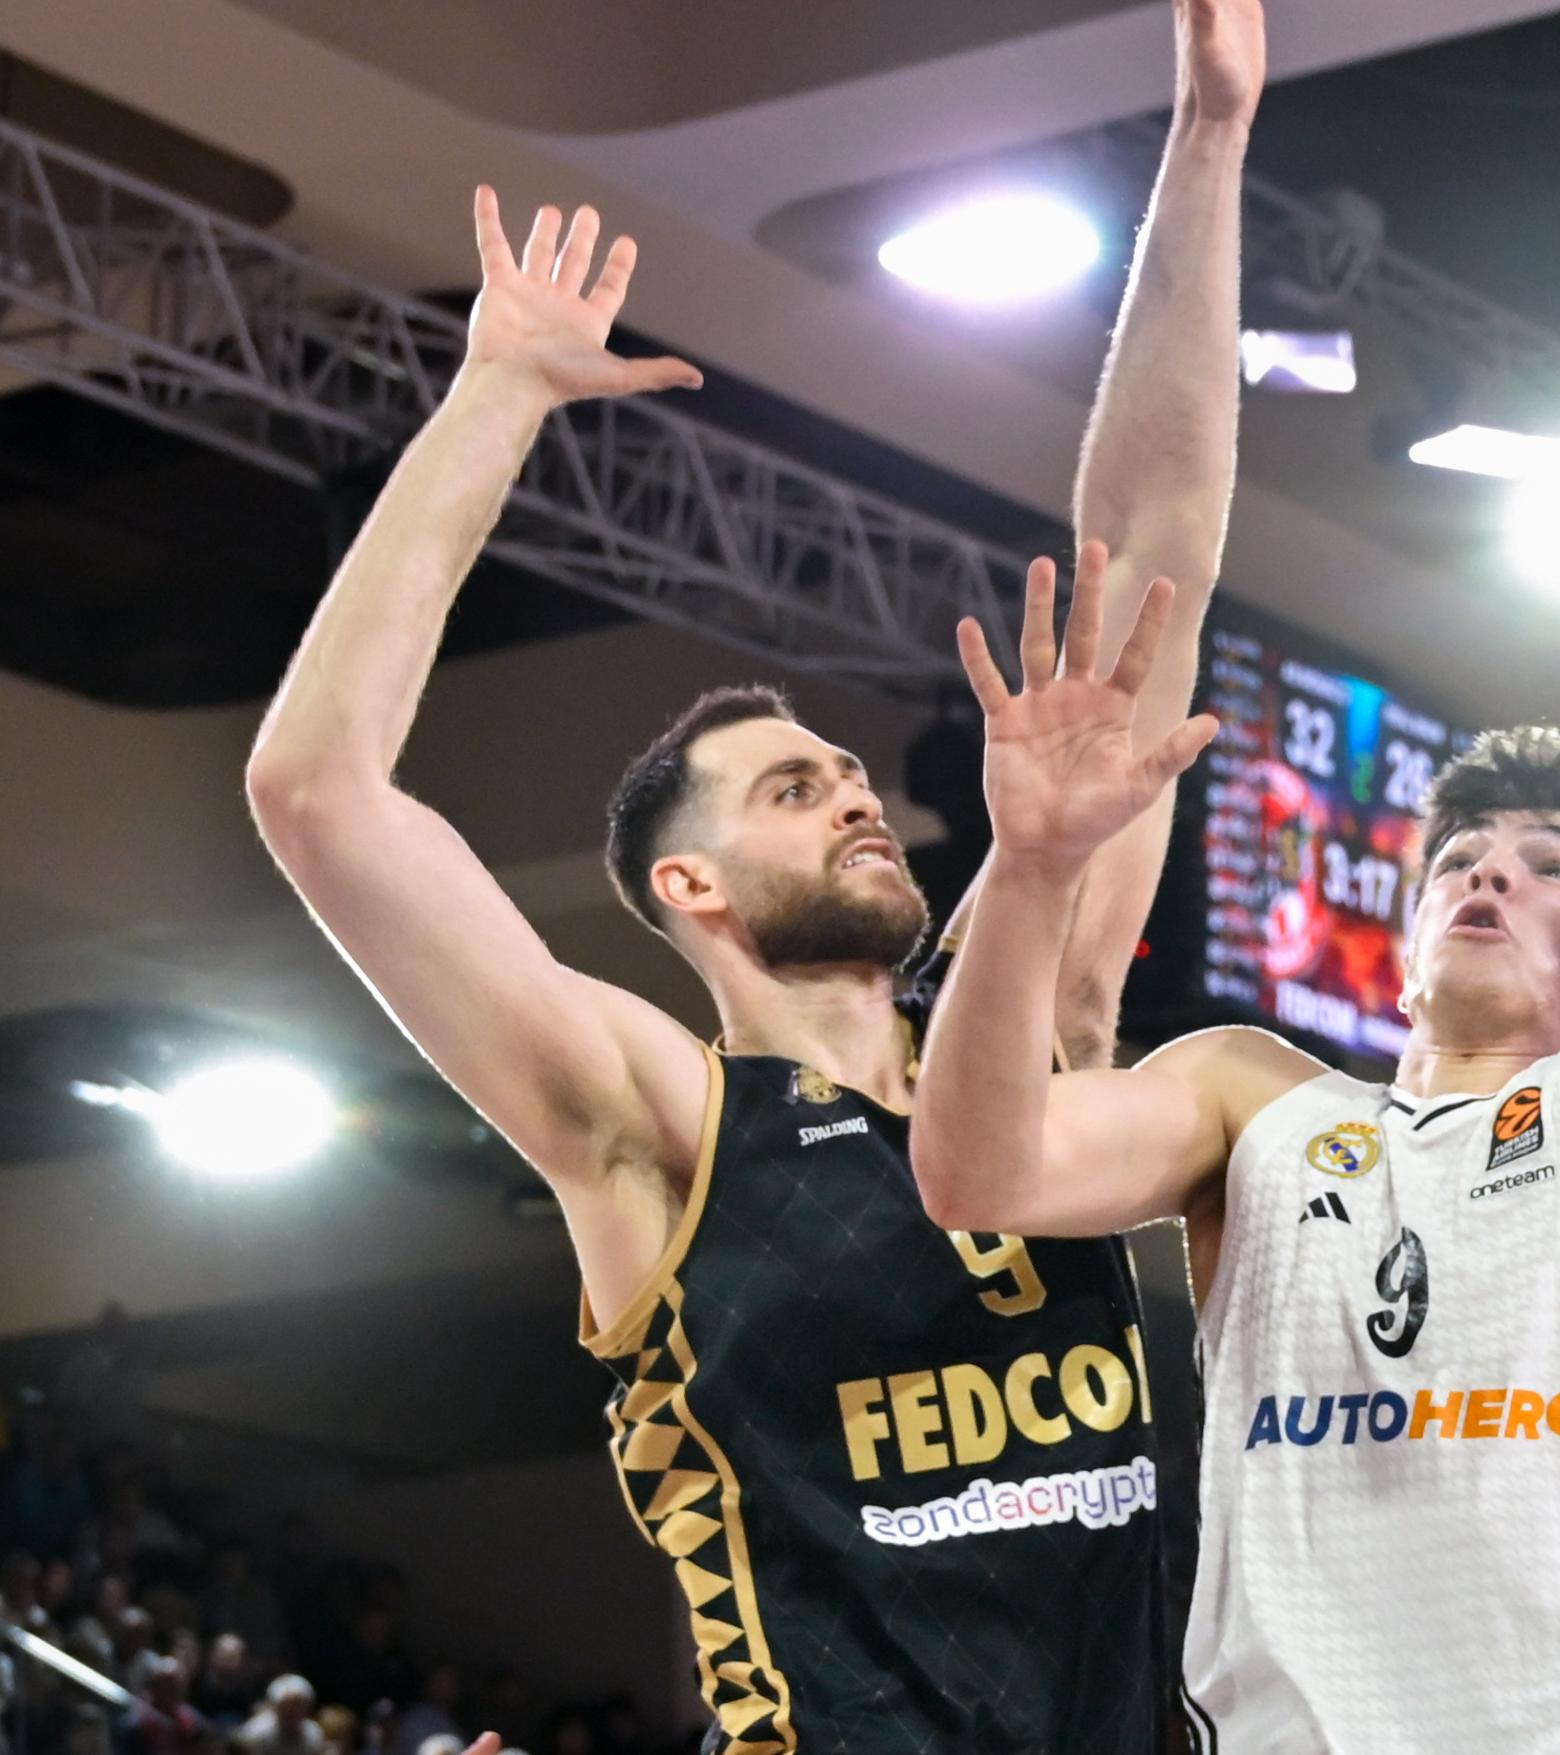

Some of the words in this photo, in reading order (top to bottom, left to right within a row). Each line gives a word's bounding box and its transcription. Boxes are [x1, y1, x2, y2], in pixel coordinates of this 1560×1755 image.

[1284, 698, 1336, 778] 32
[1323, 841, 1399, 921] 3:17
[798, 1116, 869, 1146] SPALDING
[1470, 1165, 1556, 1199] oneteam
[1366, 1226, 1430, 1359] 9
[836, 1323, 1153, 1482] FEDCO
